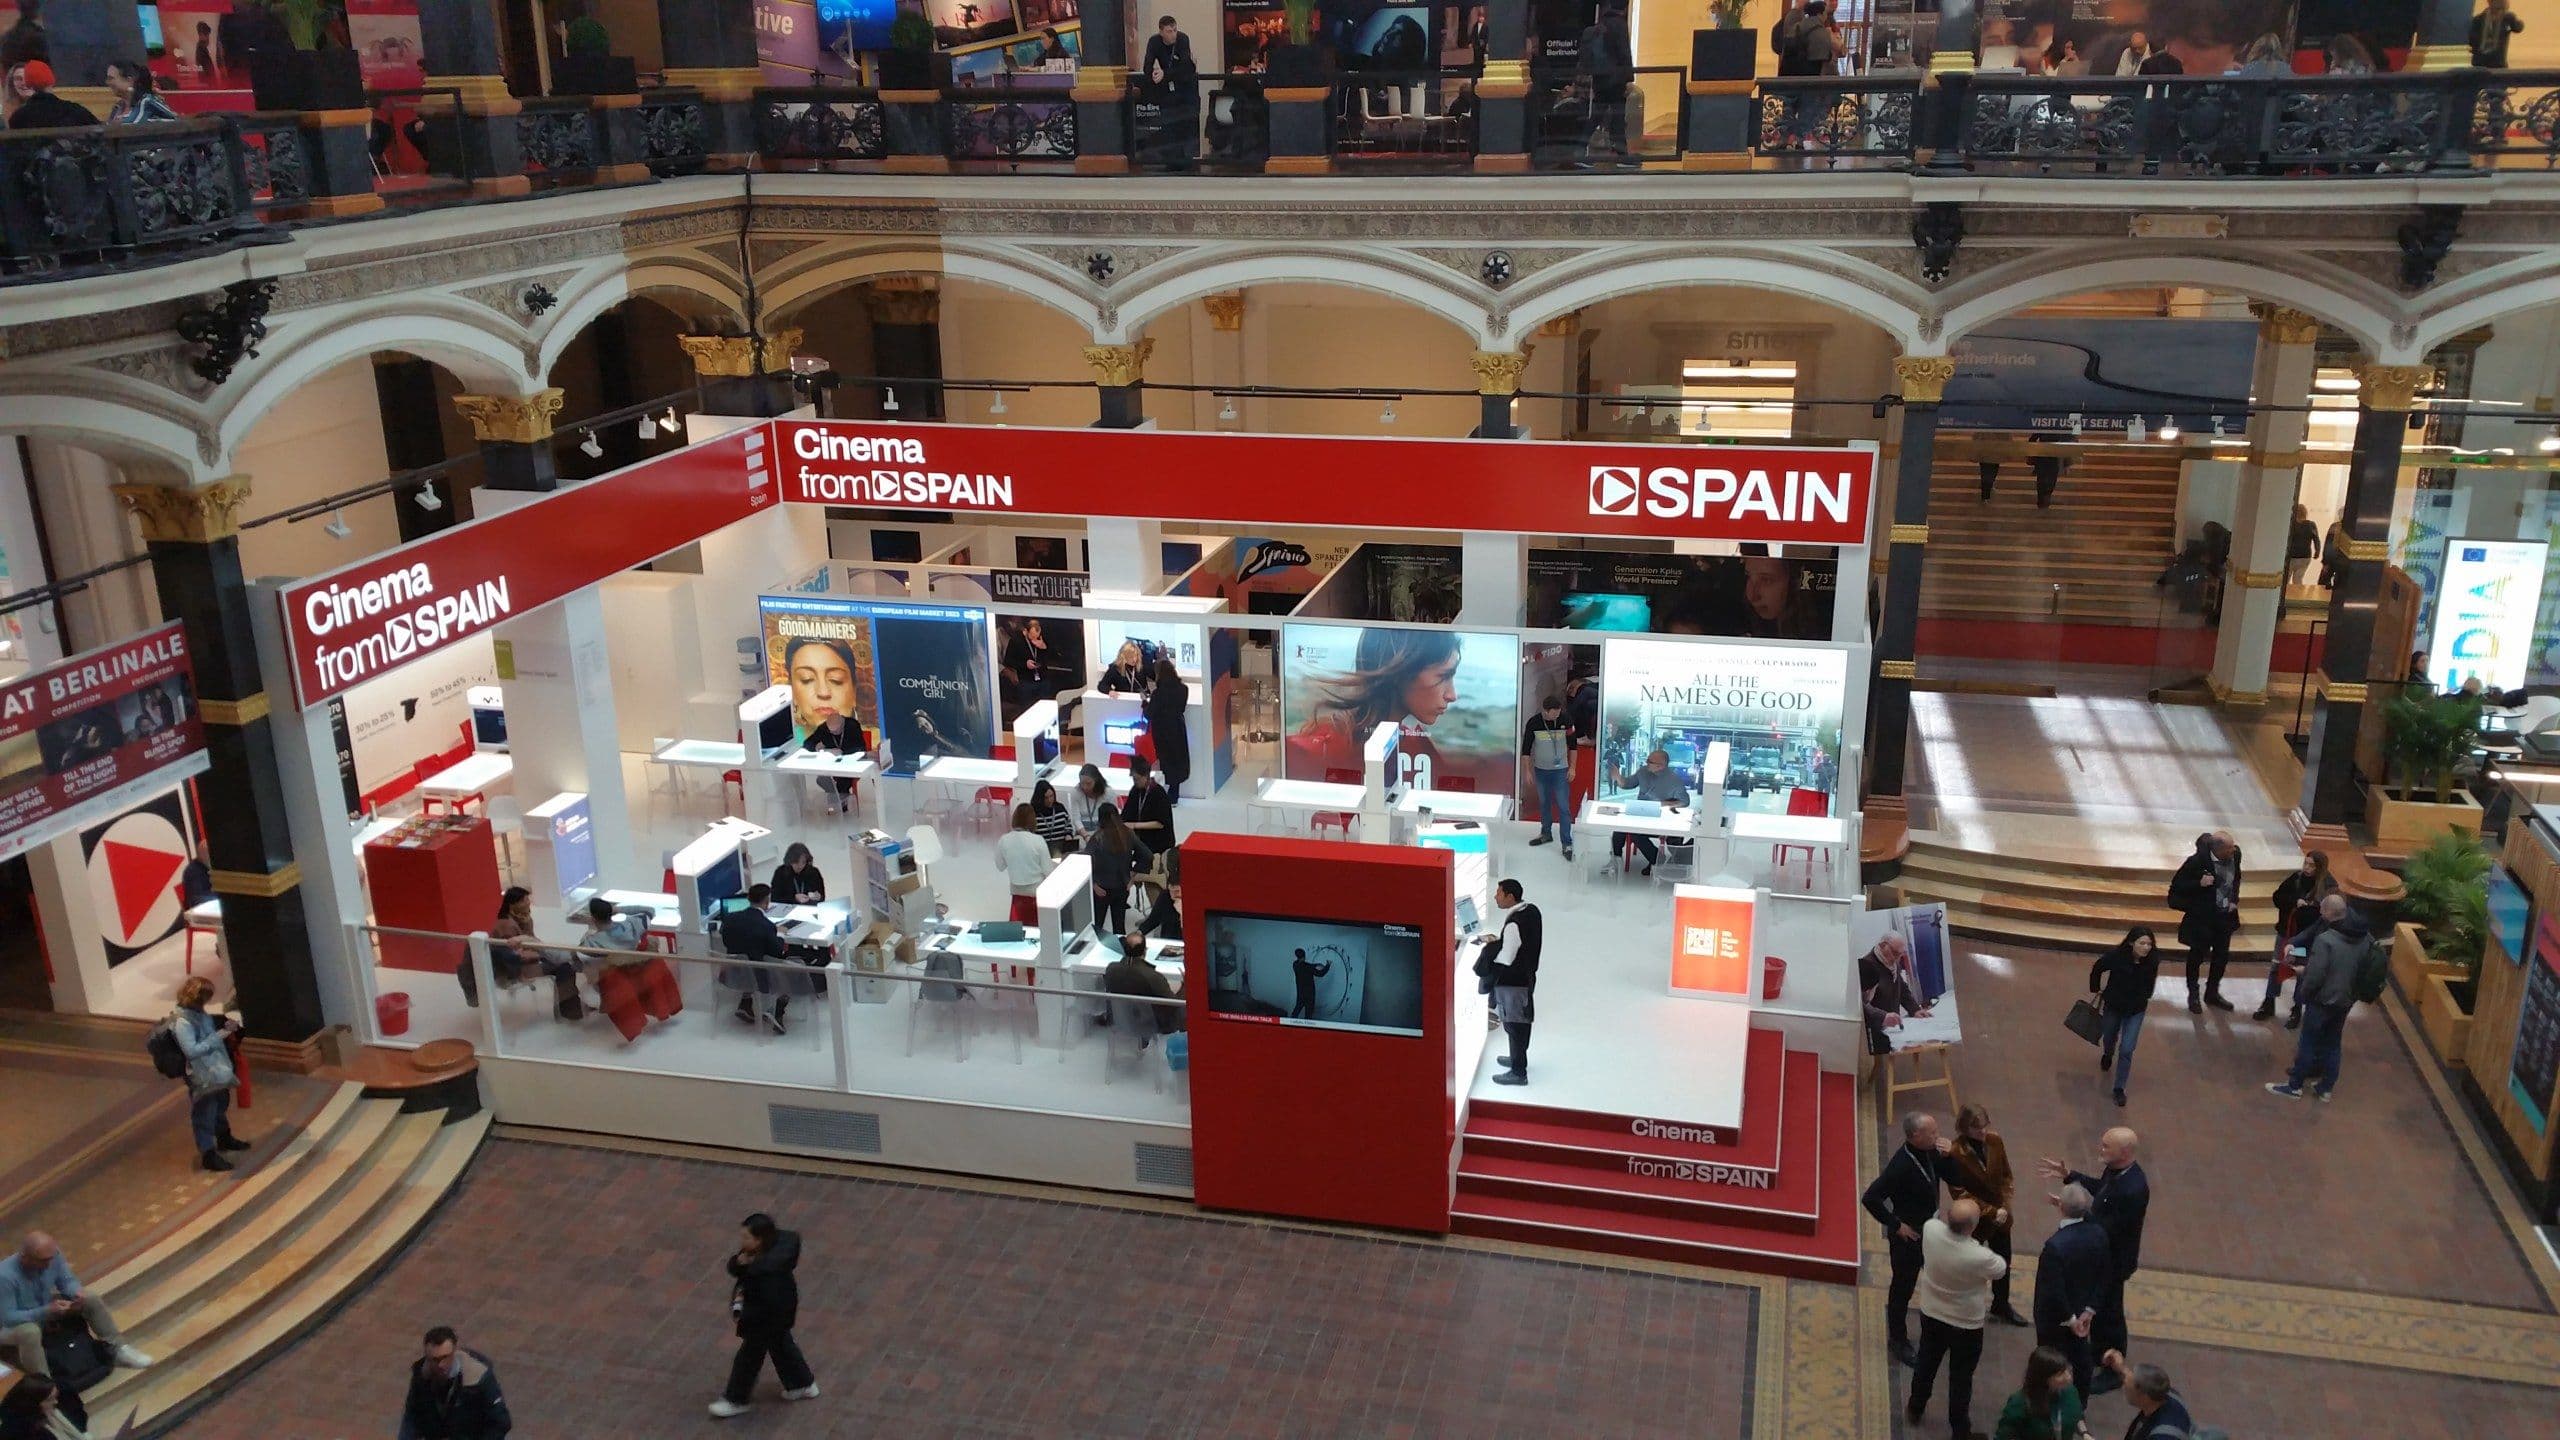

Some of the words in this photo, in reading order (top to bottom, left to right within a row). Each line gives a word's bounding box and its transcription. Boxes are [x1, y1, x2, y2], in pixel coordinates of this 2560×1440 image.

[2031, 417, 2058, 428] VISIT
[2090, 418, 2108, 428] SEE
[2111, 418, 2125, 428] NL
[794, 428, 925, 464] Cinema
[799, 466, 870, 500] from
[904, 471, 1013, 506] SPAIN
[1645, 467, 1852, 523] SPAIN
[1614, 565, 1658, 574] Generation
[1614, 575, 1640, 583] World
[1641, 576, 1679, 585] Premiere
[305, 562, 433, 635] Cinema
[315, 633, 389, 691] from
[414, 575, 511, 648] SPAIN
[4, 686, 36, 719] AT
[48, 633, 185, 701] BERLINALE
[899, 677, 969, 690] COMMUNION
[1692, 674, 1725, 687] ALL
[1728, 675, 1760, 688] THE
[51, 693, 101, 718] COMPETITION
[923, 688, 946, 699] GIRL
[1640, 685, 1721, 707] NAMES
[1726, 690, 1758, 708] OF
[1761, 691, 1812, 710] GOD
[1631, 1118, 1717, 1144] Cinema
[1627, 1156, 1674, 1178] from
[1696, 1164, 1769, 1190] SPAIN
